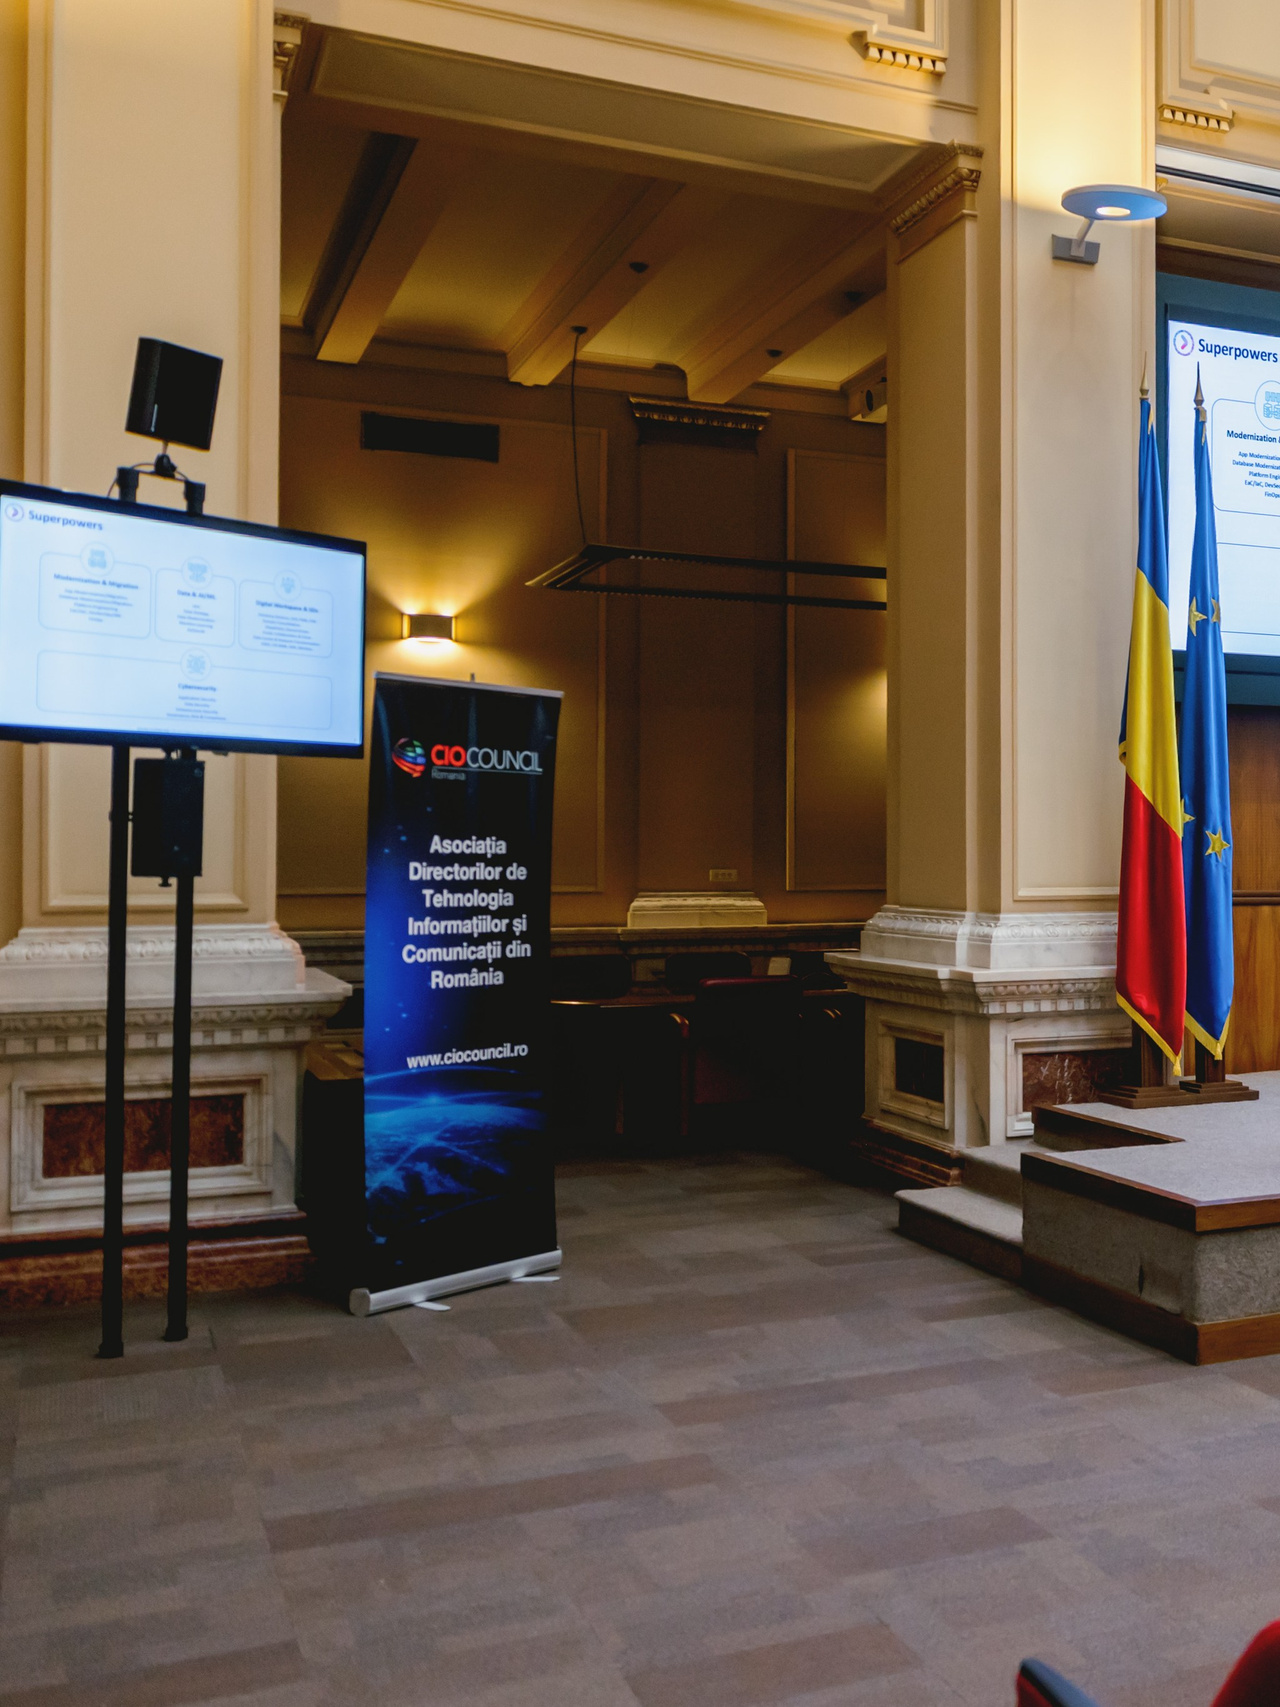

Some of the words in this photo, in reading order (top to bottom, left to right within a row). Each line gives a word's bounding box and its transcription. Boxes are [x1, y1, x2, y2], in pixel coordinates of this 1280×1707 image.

[1198, 338, 1278, 363] Superpowers
[1226, 430, 1277, 443] Modernization
[28, 509, 103, 531] Superpowers
[431, 769, 466, 781] Romania
[429, 834, 507, 859] Asociația
[409, 861, 504, 880] Directorilor
[505, 862, 528, 880] de
[422, 888, 514, 911] Tehnologia
[408, 915, 510, 938] Informațiilor
[512, 914, 527, 936] și
[402, 940, 502, 964] Comunicații
[505, 940, 531, 958] din
[431, 967, 504, 989] România
[406, 1043, 529, 1069] www.ciocouncil.ro
